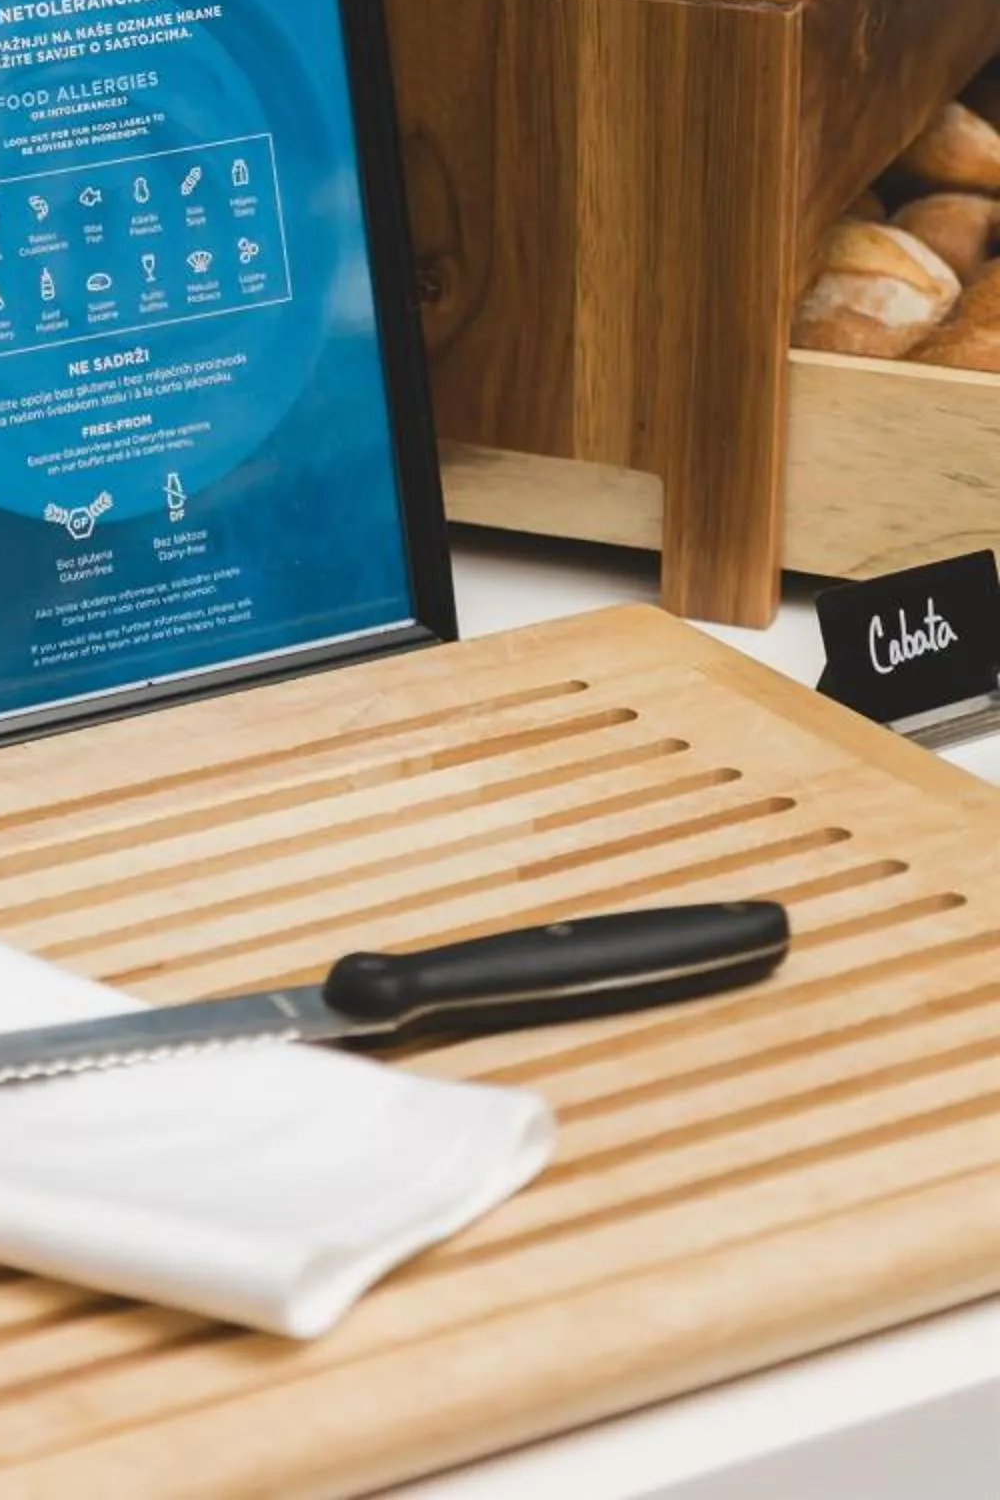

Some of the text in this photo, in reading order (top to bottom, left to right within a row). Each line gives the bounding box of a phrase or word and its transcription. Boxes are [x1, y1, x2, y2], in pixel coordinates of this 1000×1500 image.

[52, 29, 71, 44] NA
[117, 12, 173, 33] OZNAKE
[37, 43, 85, 62] SAVJET
[55, 70, 158, 102] ALLERGIES
[51, 128, 68, 139] FOR
[68, 345, 149, 377] NE SADRŽI
[81, 413, 152, 438] FREE-FROM
[869, 596, 958, 674] Cabata
